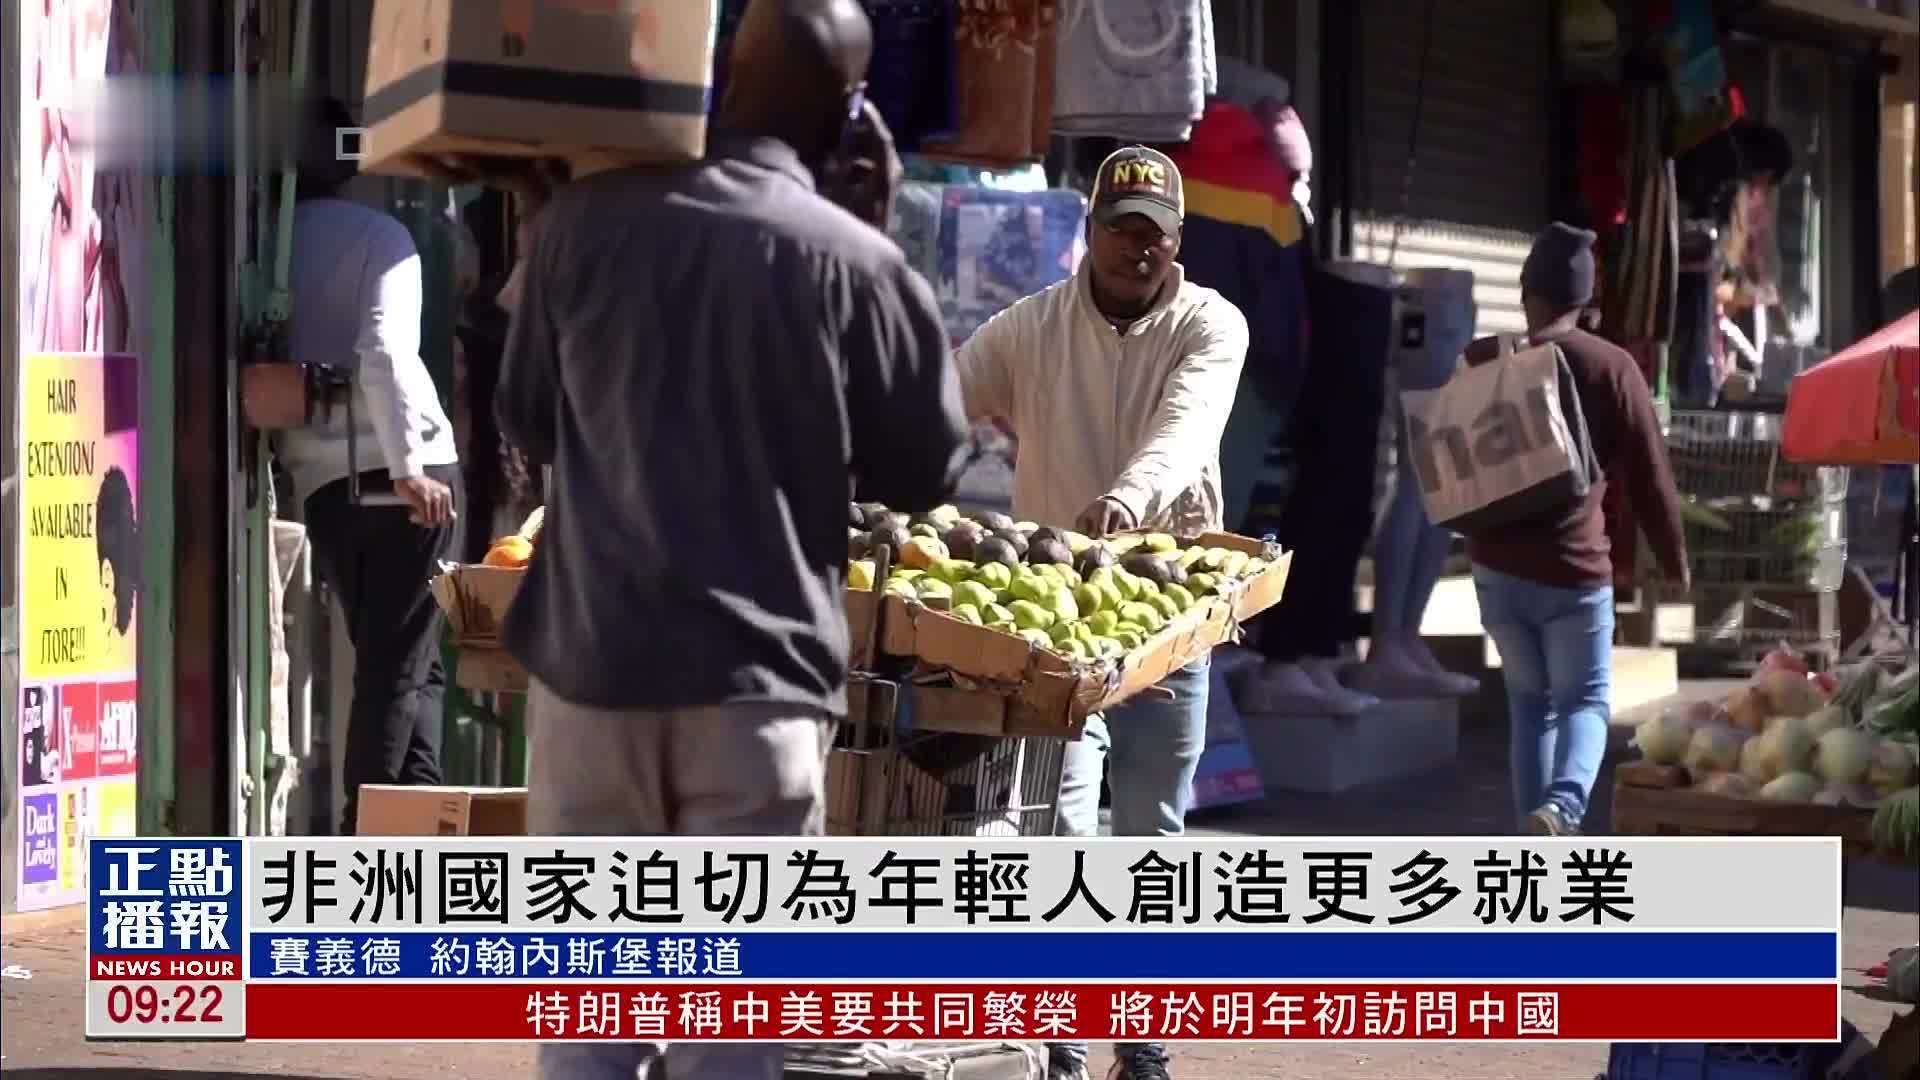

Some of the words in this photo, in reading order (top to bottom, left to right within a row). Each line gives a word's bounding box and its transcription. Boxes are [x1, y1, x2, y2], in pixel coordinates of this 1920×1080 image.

[1113, 160, 1165, 185] NYC
[47, 379, 77, 415] HAIR
[30, 503, 93, 540] AVAILABLE
[55, 566, 68, 600] IN
[26, 802, 55, 836] Dark
[25, 839, 56, 870] Lovely
